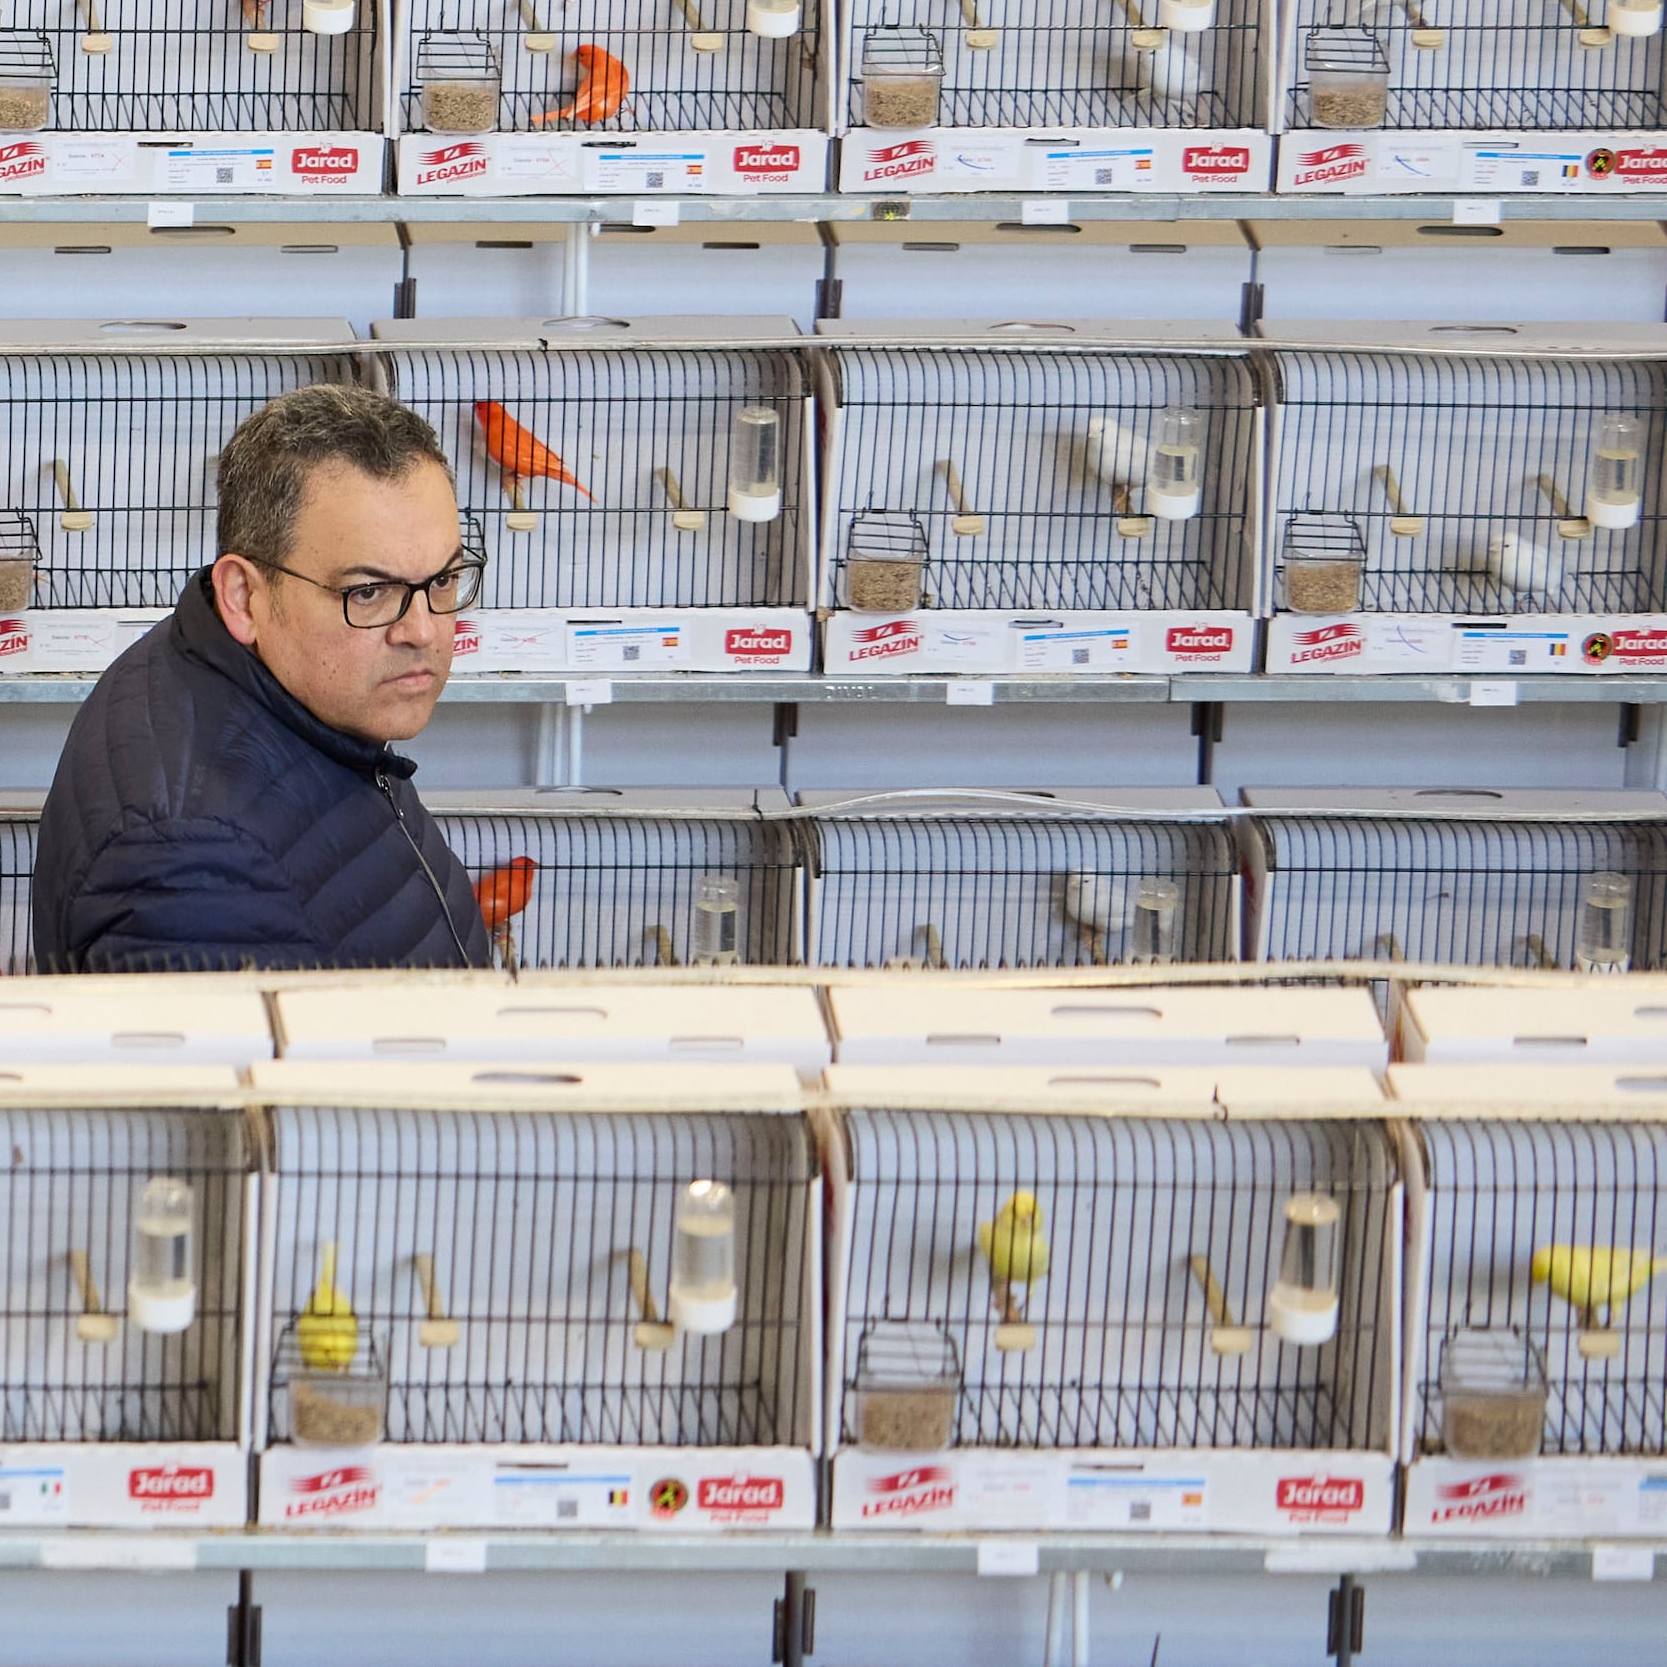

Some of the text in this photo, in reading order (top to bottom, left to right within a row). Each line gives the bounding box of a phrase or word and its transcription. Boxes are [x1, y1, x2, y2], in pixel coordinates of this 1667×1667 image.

[297, 154, 353, 168] Jarad
[739, 152, 793, 166] Jarad
[1189, 152, 1243, 167] Jarad
[417, 157, 488, 184] LEGAZÍN
[865, 154, 936, 182] LEGAZÍN
[1296, 158, 1367, 186] LEGAZÍN
[303, 176, 349, 184] Pet Food
[743, 174, 787, 182] Pet Food
[1193, 175, 1237, 184] Pet Food
[1623, 176, 1641, 184] Pet
[731, 634, 785, 649] Jarad
[1171, 632, 1227, 647] Jarad
[850, 634, 921, 662] LEGAZÍN
[1292, 637, 1363, 664] LEGAZÍN
[735, 657, 779, 666] Pet Food
[1175, 655, 1221, 664] Pet Food
[1639, 657, 1664, 665] Food
[137, 1473, 207, 1493] Jarad
[705, 1484, 776, 1504] Jarad
[1285, 1484, 1355, 1504] Jarad
